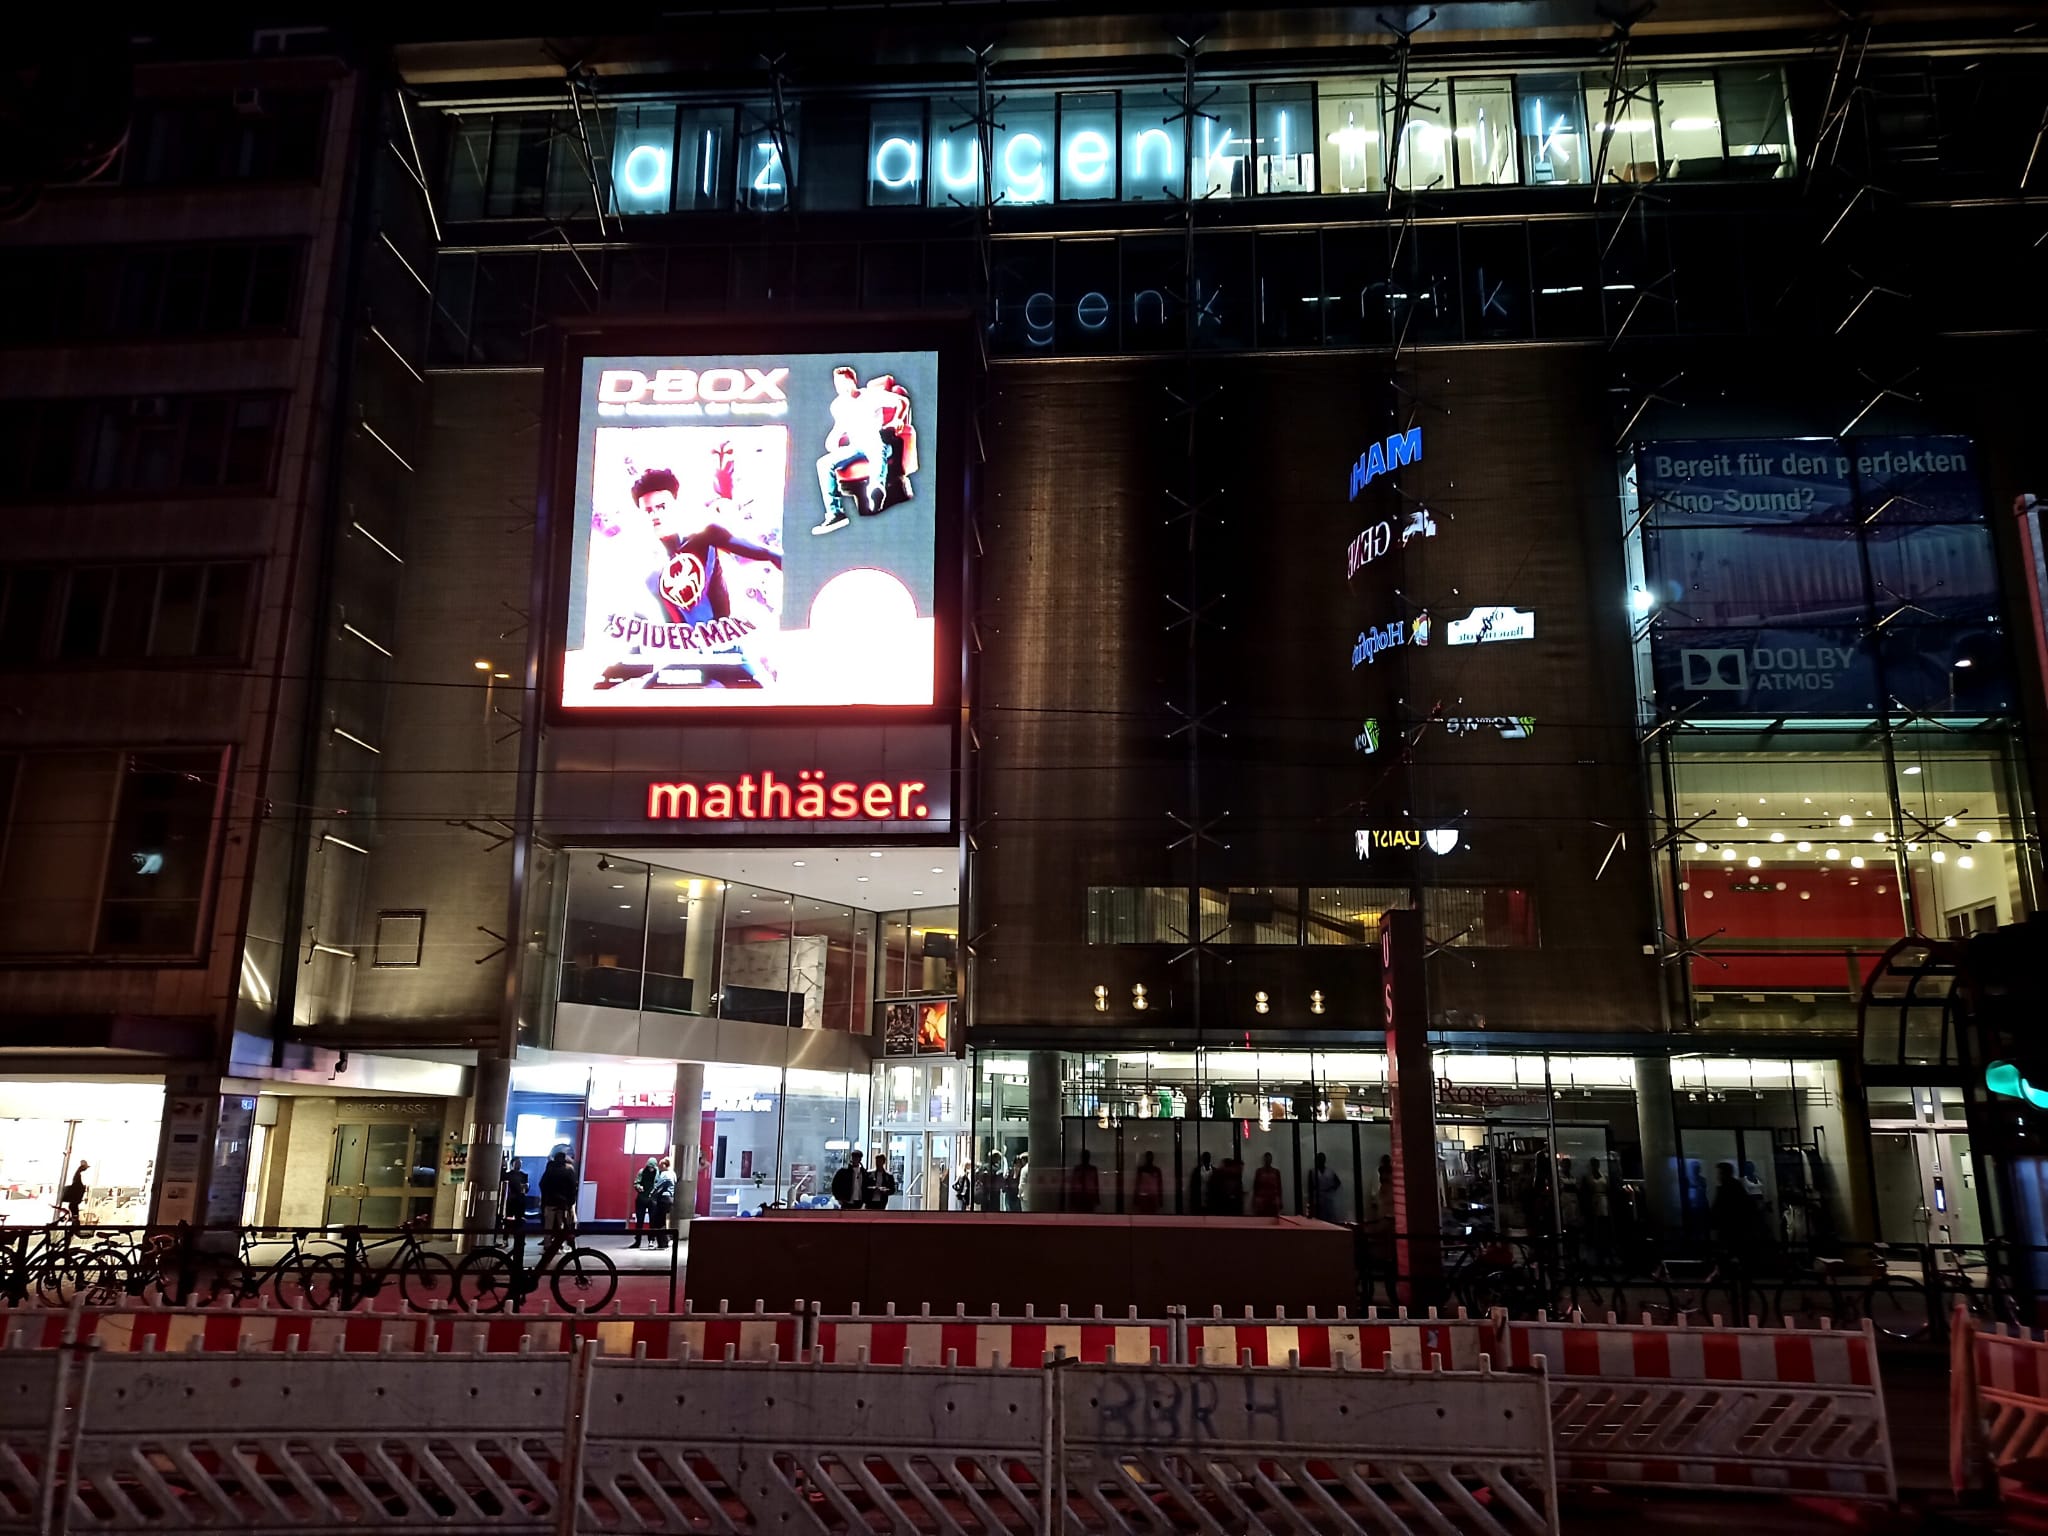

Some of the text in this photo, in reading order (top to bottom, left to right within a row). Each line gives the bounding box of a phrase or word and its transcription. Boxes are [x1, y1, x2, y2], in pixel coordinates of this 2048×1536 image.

[597, 368, 790, 402] D-BOX
[1656, 451, 1967, 479] Bereit für den perfekten
[1659, 487, 1816, 514] Kino-Sound?
[1753, 647, 1855, 671] DOLBY
[1756, 673, 1834, 691] ATMOS
[648, 769, 929, 820] mathäser.
[1382, 931, 1390, 969] U
[1385, 983, 1393, 1024] S
